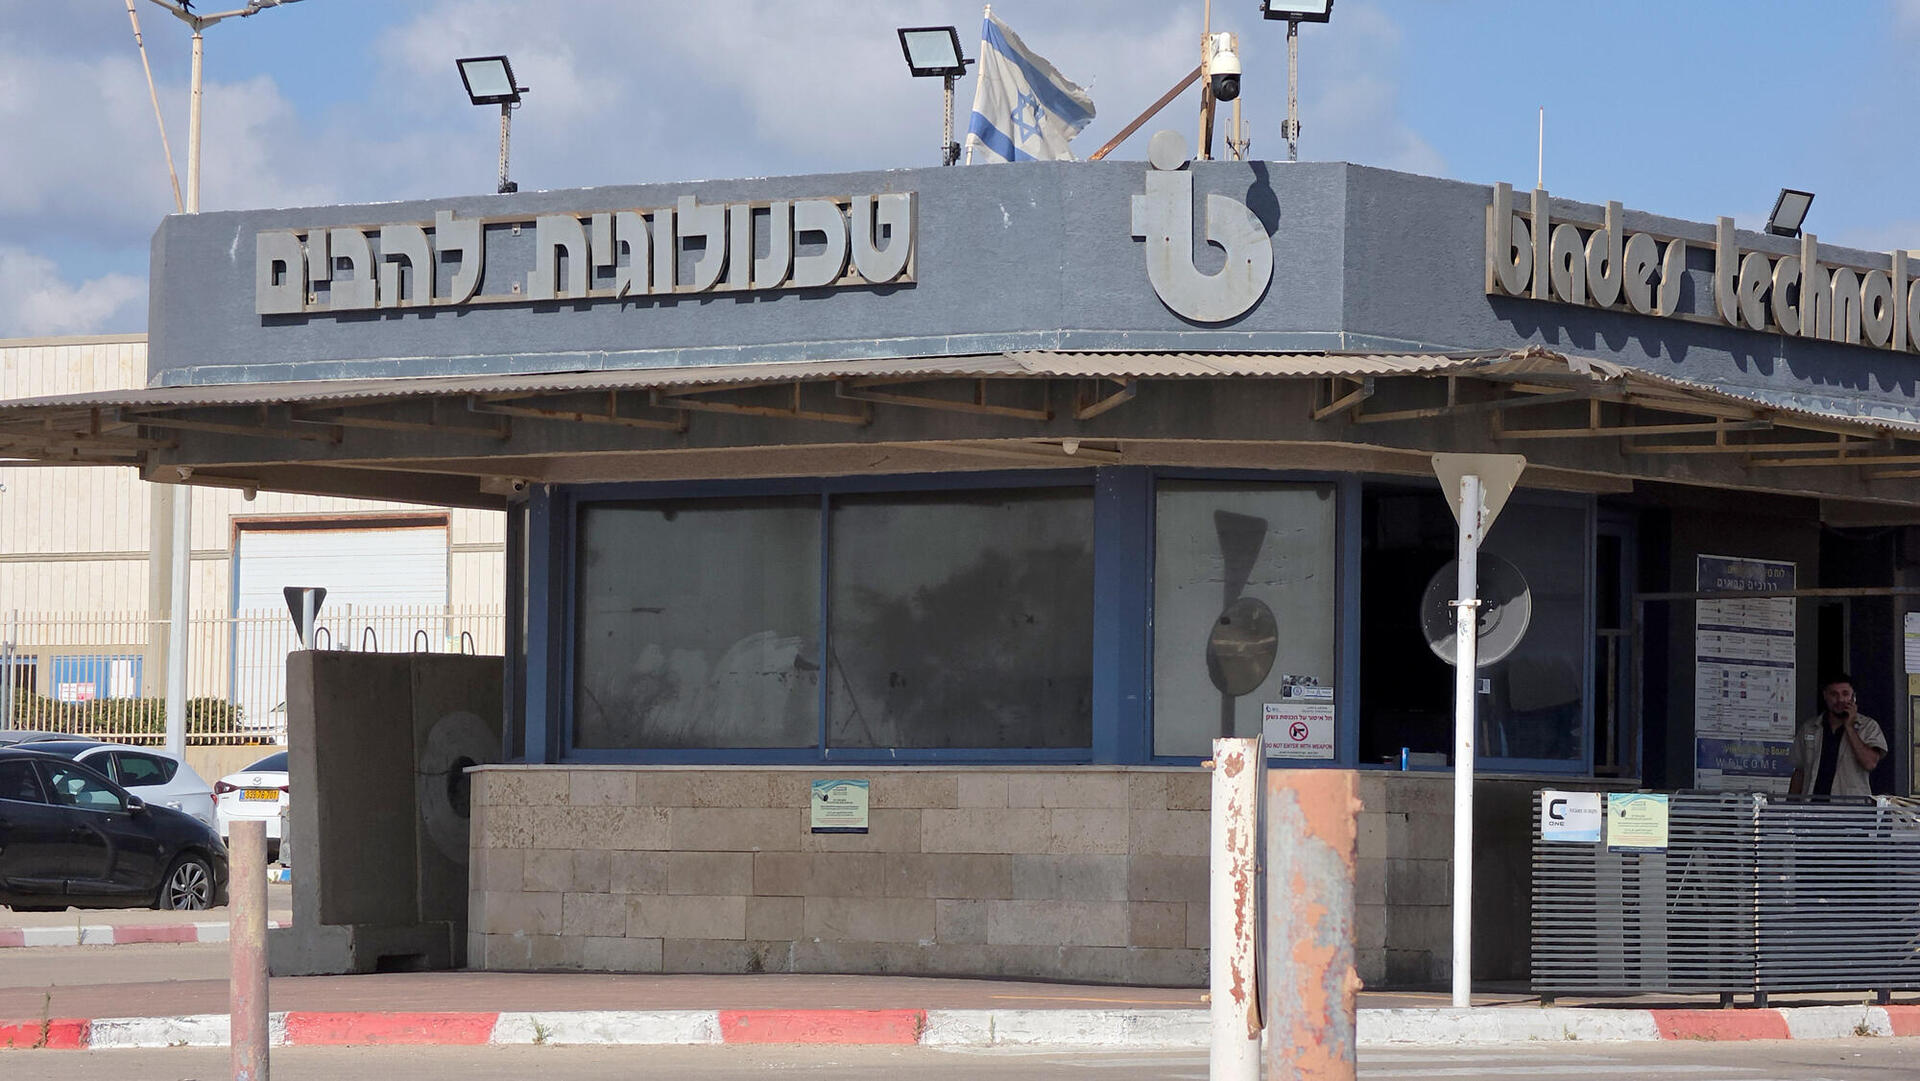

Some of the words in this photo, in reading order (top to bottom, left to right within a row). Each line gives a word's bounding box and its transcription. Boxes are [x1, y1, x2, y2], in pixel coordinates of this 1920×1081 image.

[256, 210, 482, 314] להבים
[528, 192, 914, 300] טכנולוגית
[1493, 182, 1686, 317] blades
